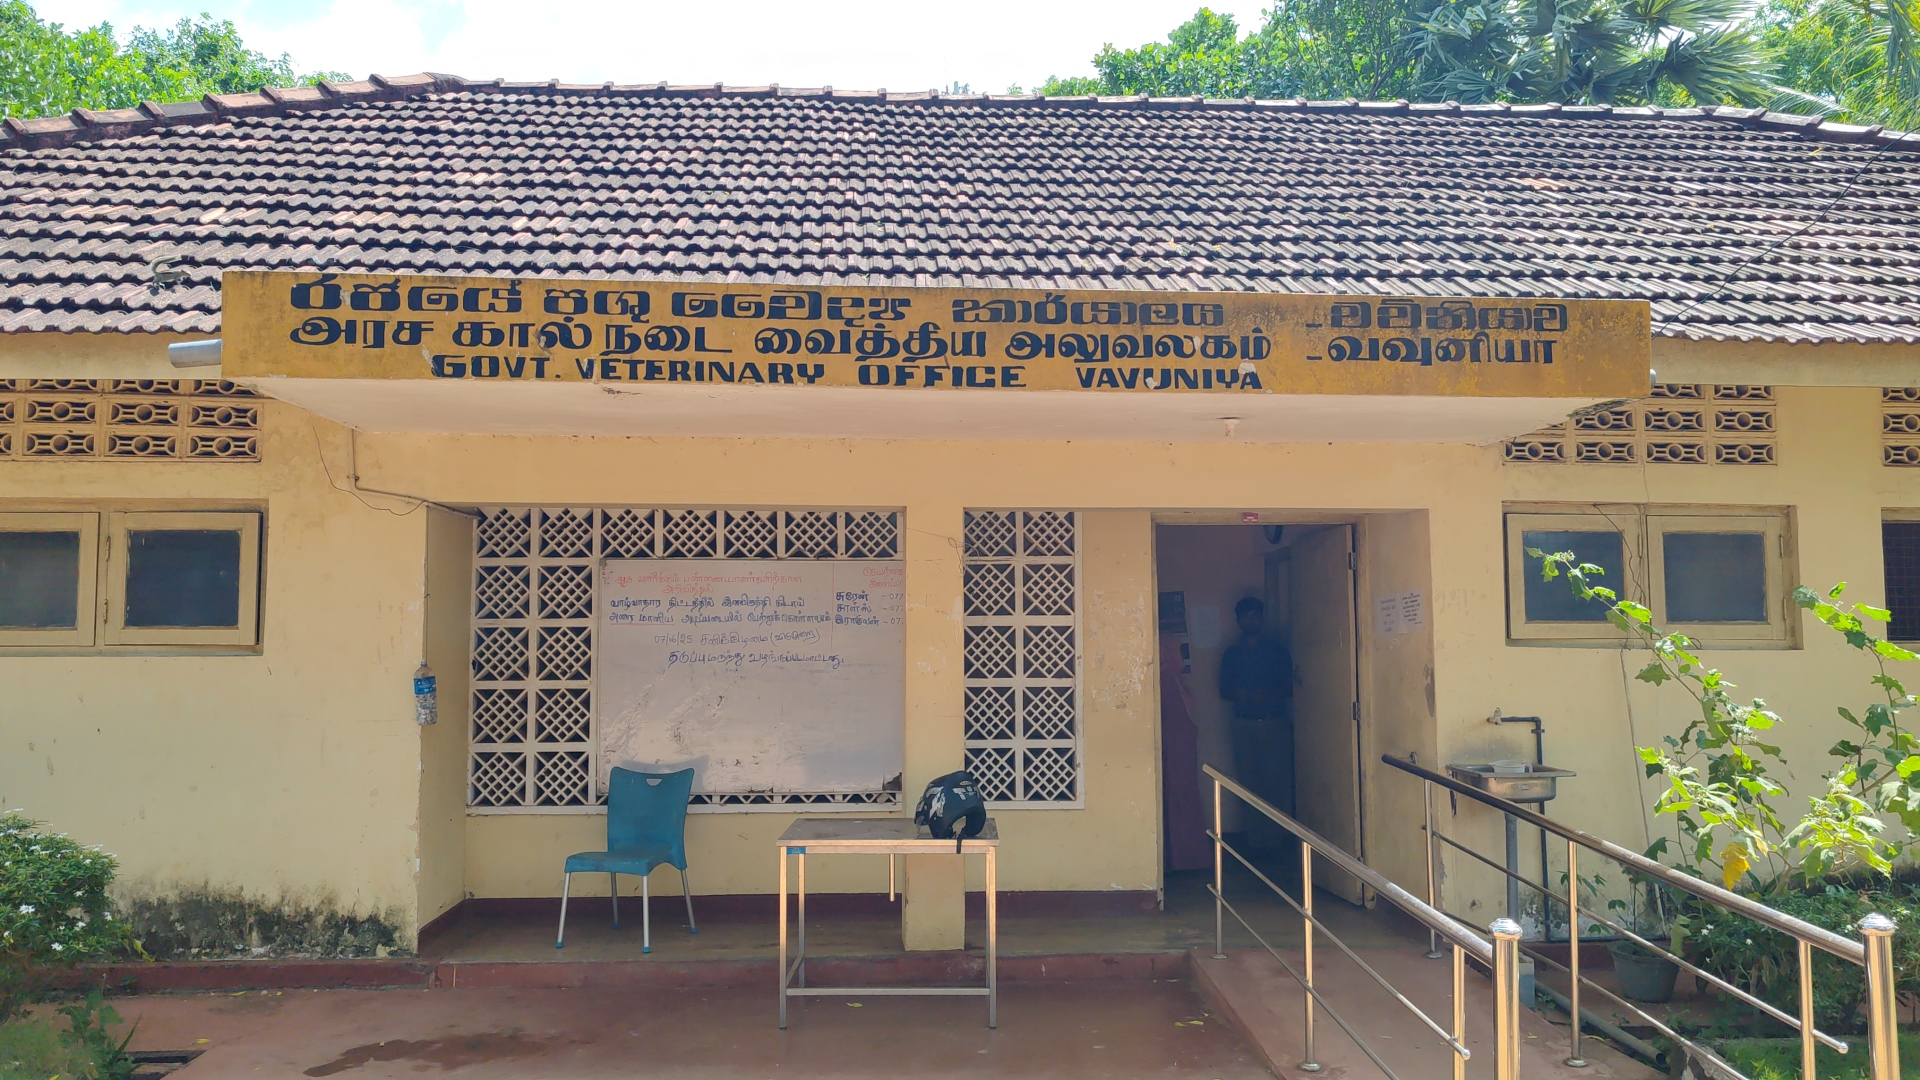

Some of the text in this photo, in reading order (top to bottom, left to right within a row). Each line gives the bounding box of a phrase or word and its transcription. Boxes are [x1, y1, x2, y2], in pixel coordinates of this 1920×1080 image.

[289, 316, 435, 349] அரச
[754, 321, 987, 363] வைத்திய
[1004, 326, 1272, 364] அலுவலகம்
[430, 354, 1263, 390] GOVT. VETERINARY OFFICE VAVUNIYA
